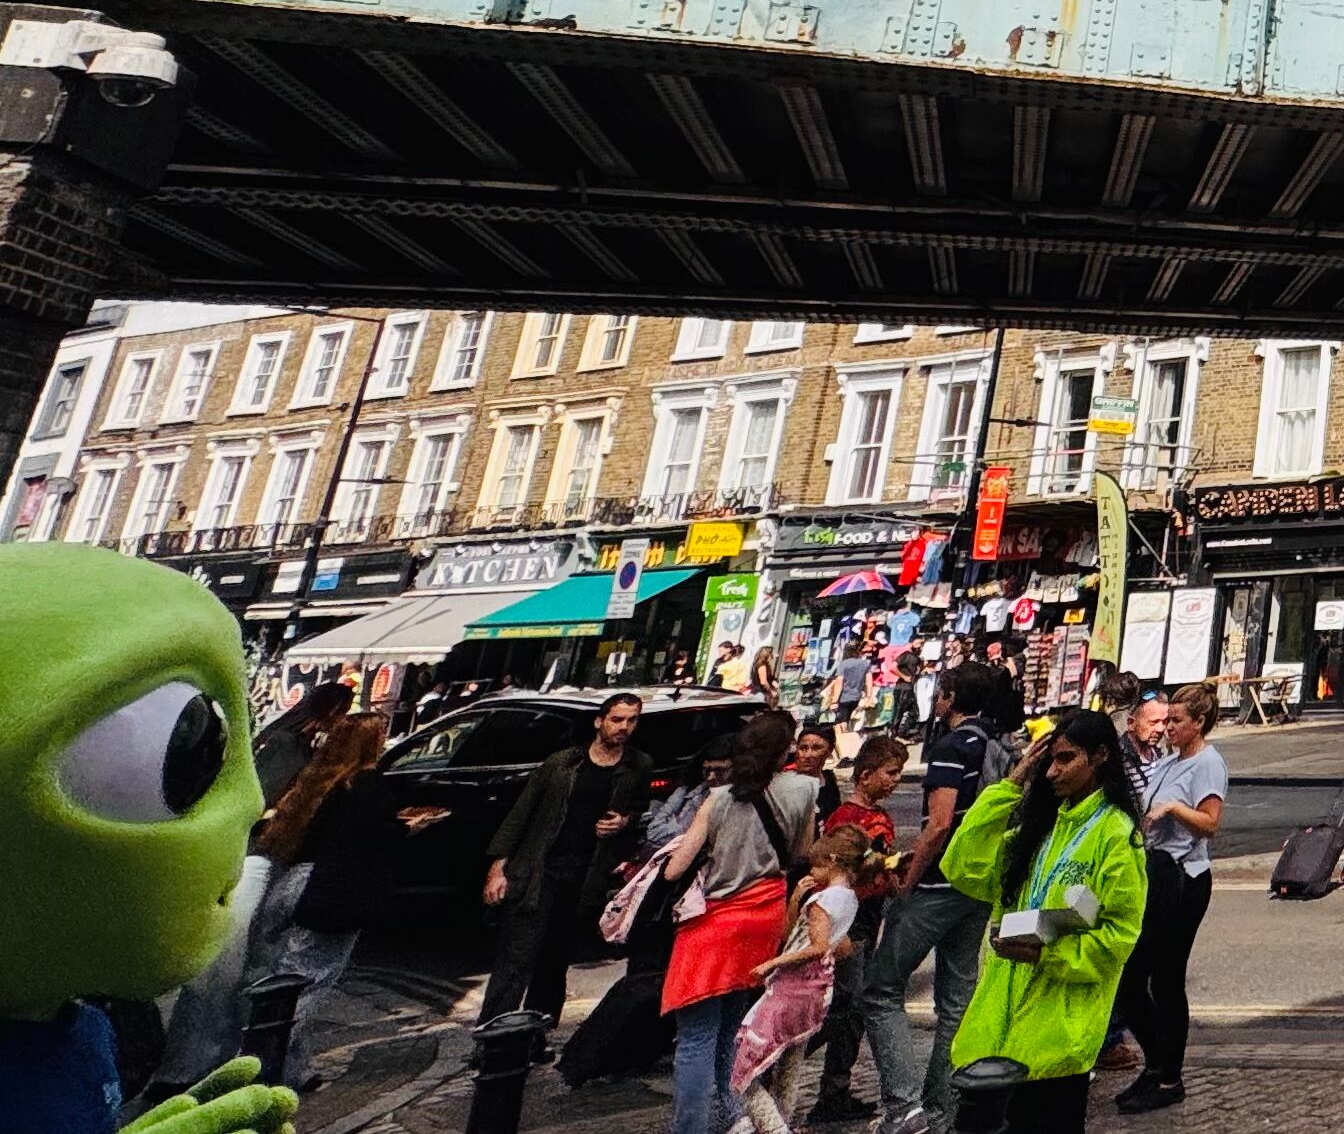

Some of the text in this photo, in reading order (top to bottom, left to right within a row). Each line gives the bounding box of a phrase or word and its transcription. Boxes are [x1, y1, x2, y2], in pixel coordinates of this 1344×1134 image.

[1199, 486, 1320, 519] CAMDEN
[834, 531, 873, 545] FOOD
[876, 530, 888, 543] &
